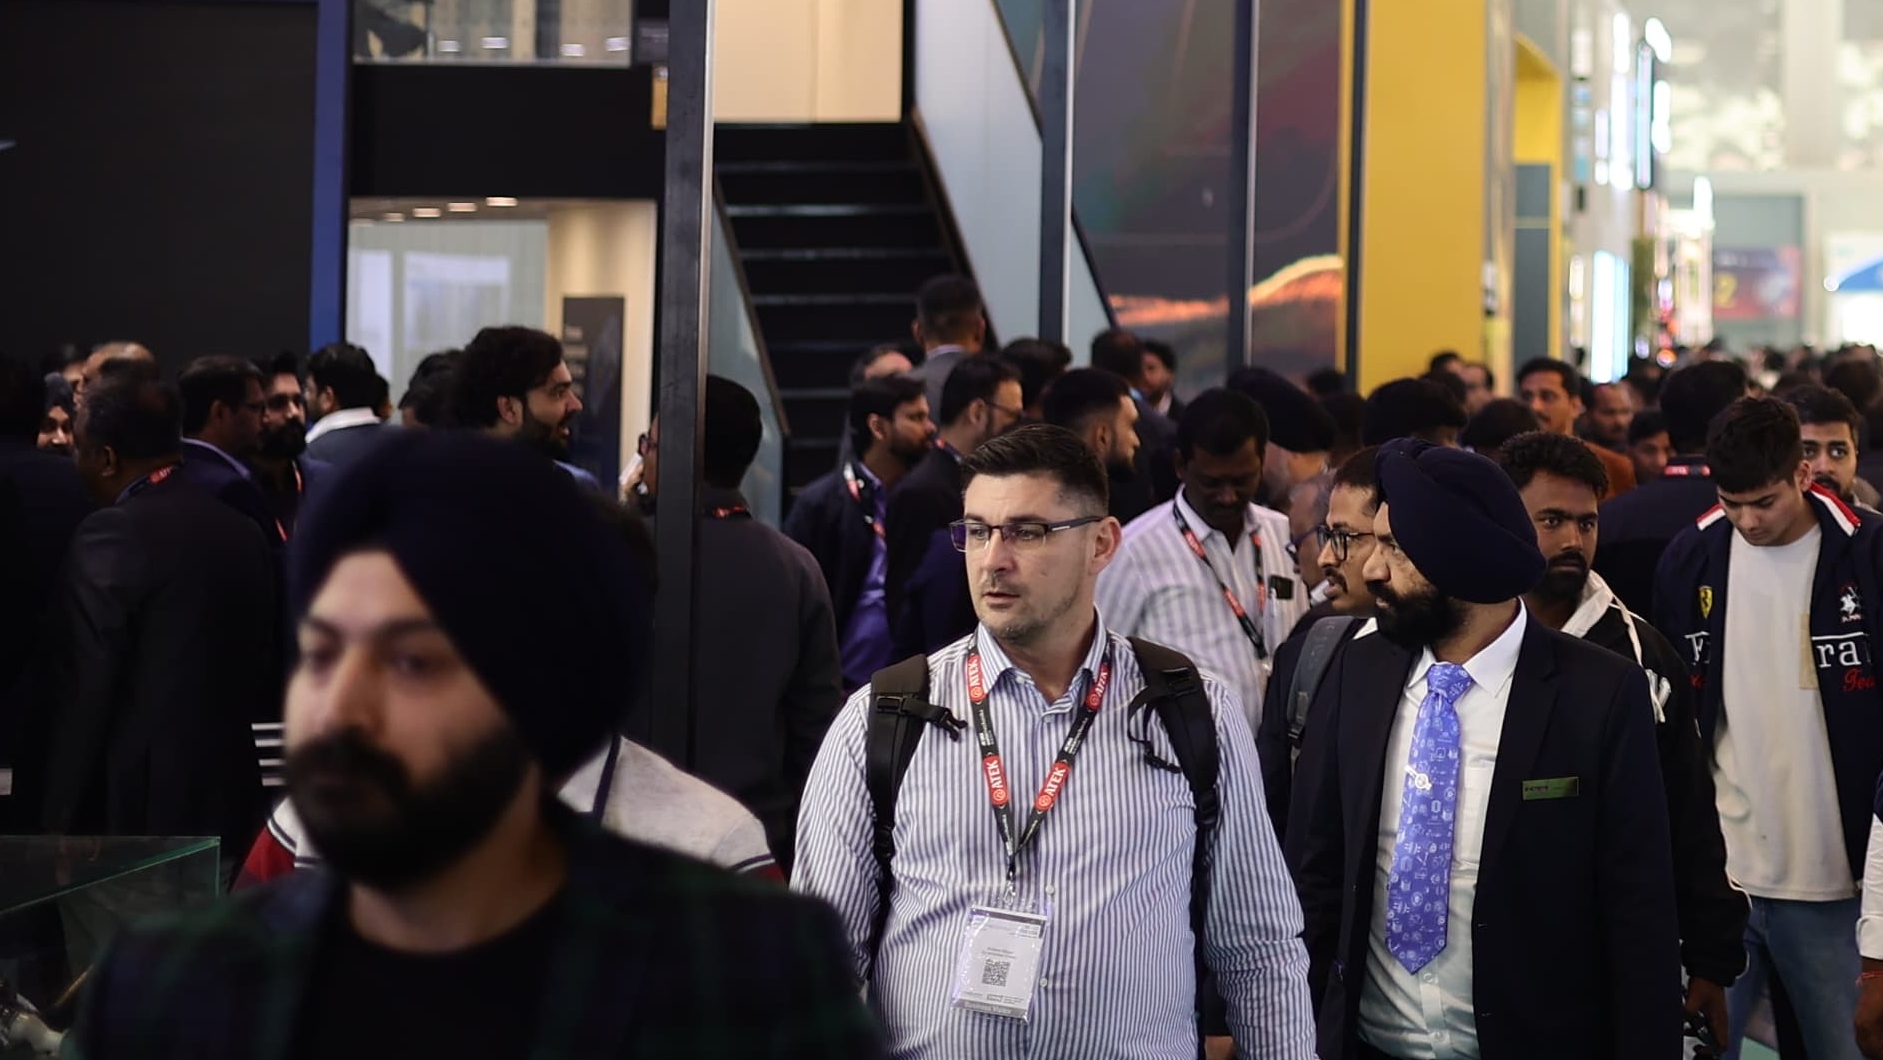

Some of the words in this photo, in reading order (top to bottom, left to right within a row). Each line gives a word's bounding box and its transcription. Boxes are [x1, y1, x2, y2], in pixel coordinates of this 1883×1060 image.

[967, 658, 979, 687] ATEK
[986, 758, 1001, 789] ATEK
[1044, 766, 1067, 798] ATEK
